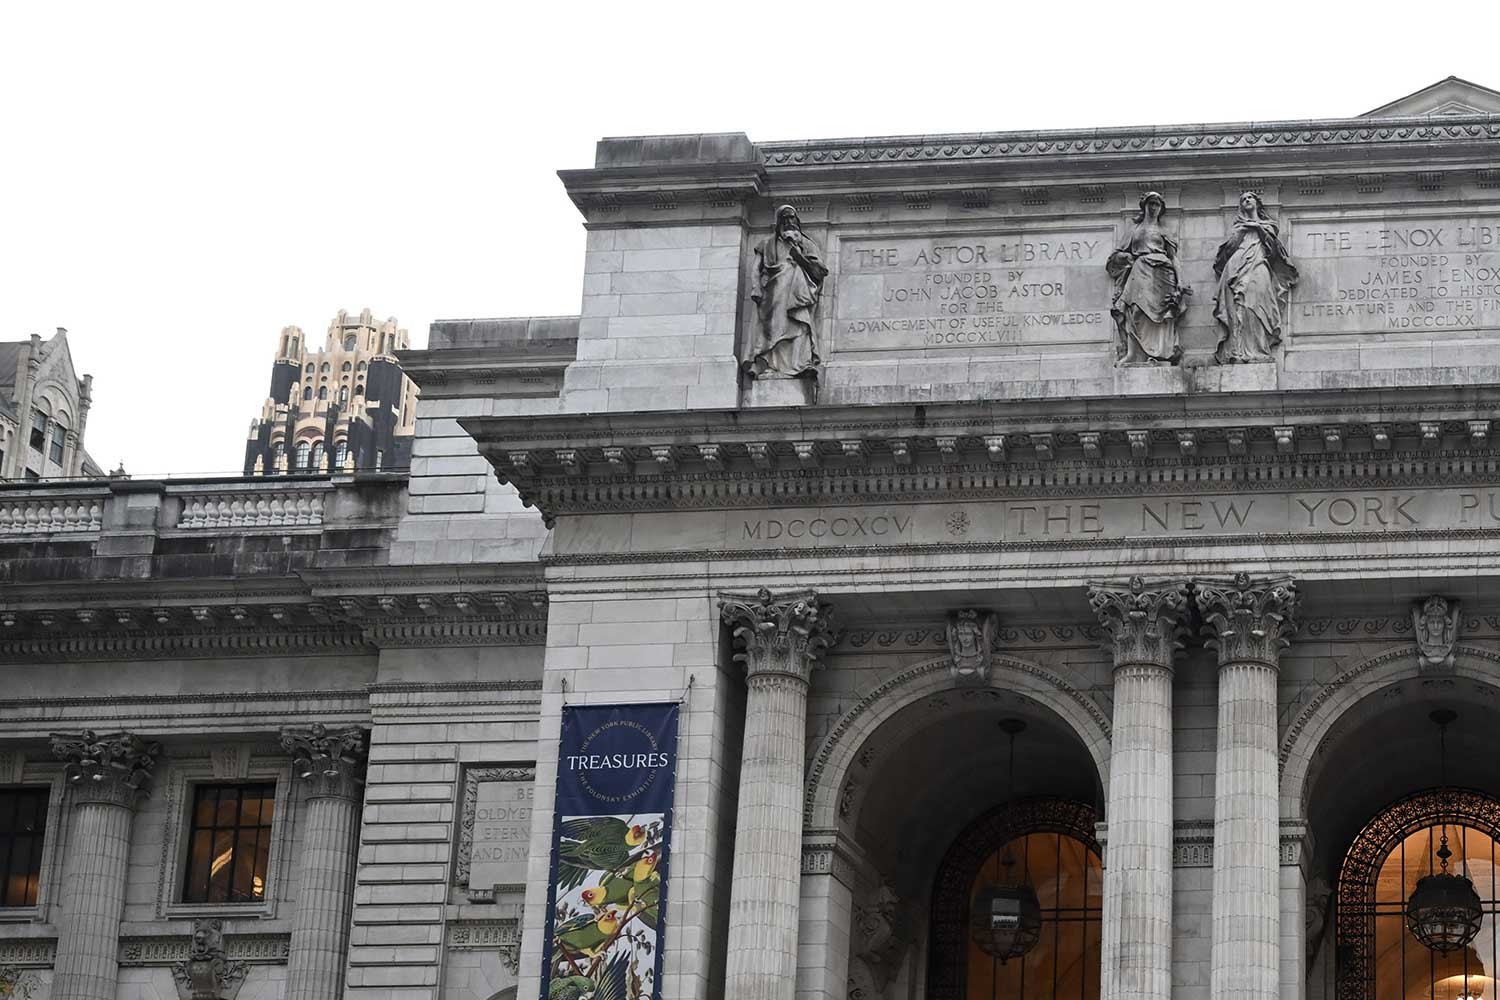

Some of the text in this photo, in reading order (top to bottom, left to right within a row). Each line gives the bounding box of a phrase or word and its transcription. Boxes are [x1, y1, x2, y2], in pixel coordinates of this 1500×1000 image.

[1307, 232, 1352, 250] THE
[1365, 228, 1442, 248] LENOX
[856, 241, 1098, 267] THE ASTOR LIBRARY
[1361, 267, 1500, 285] JAMES LENOX
[884, 283, 1064, 302] JOHN JACOB ASTOR
[1388, 314, 1475, 328] MDCCCLXX
[743, 516, 912, 540] MDCCCXCV
[1008, 504, 1104, 535] THE
[1141, 500, 1255, 531] NEW
[1295, 495, 1418, 528] YORK
[568, 752, 670, 770] TREASURES
[477, 807, 533, 820] OLD YET
